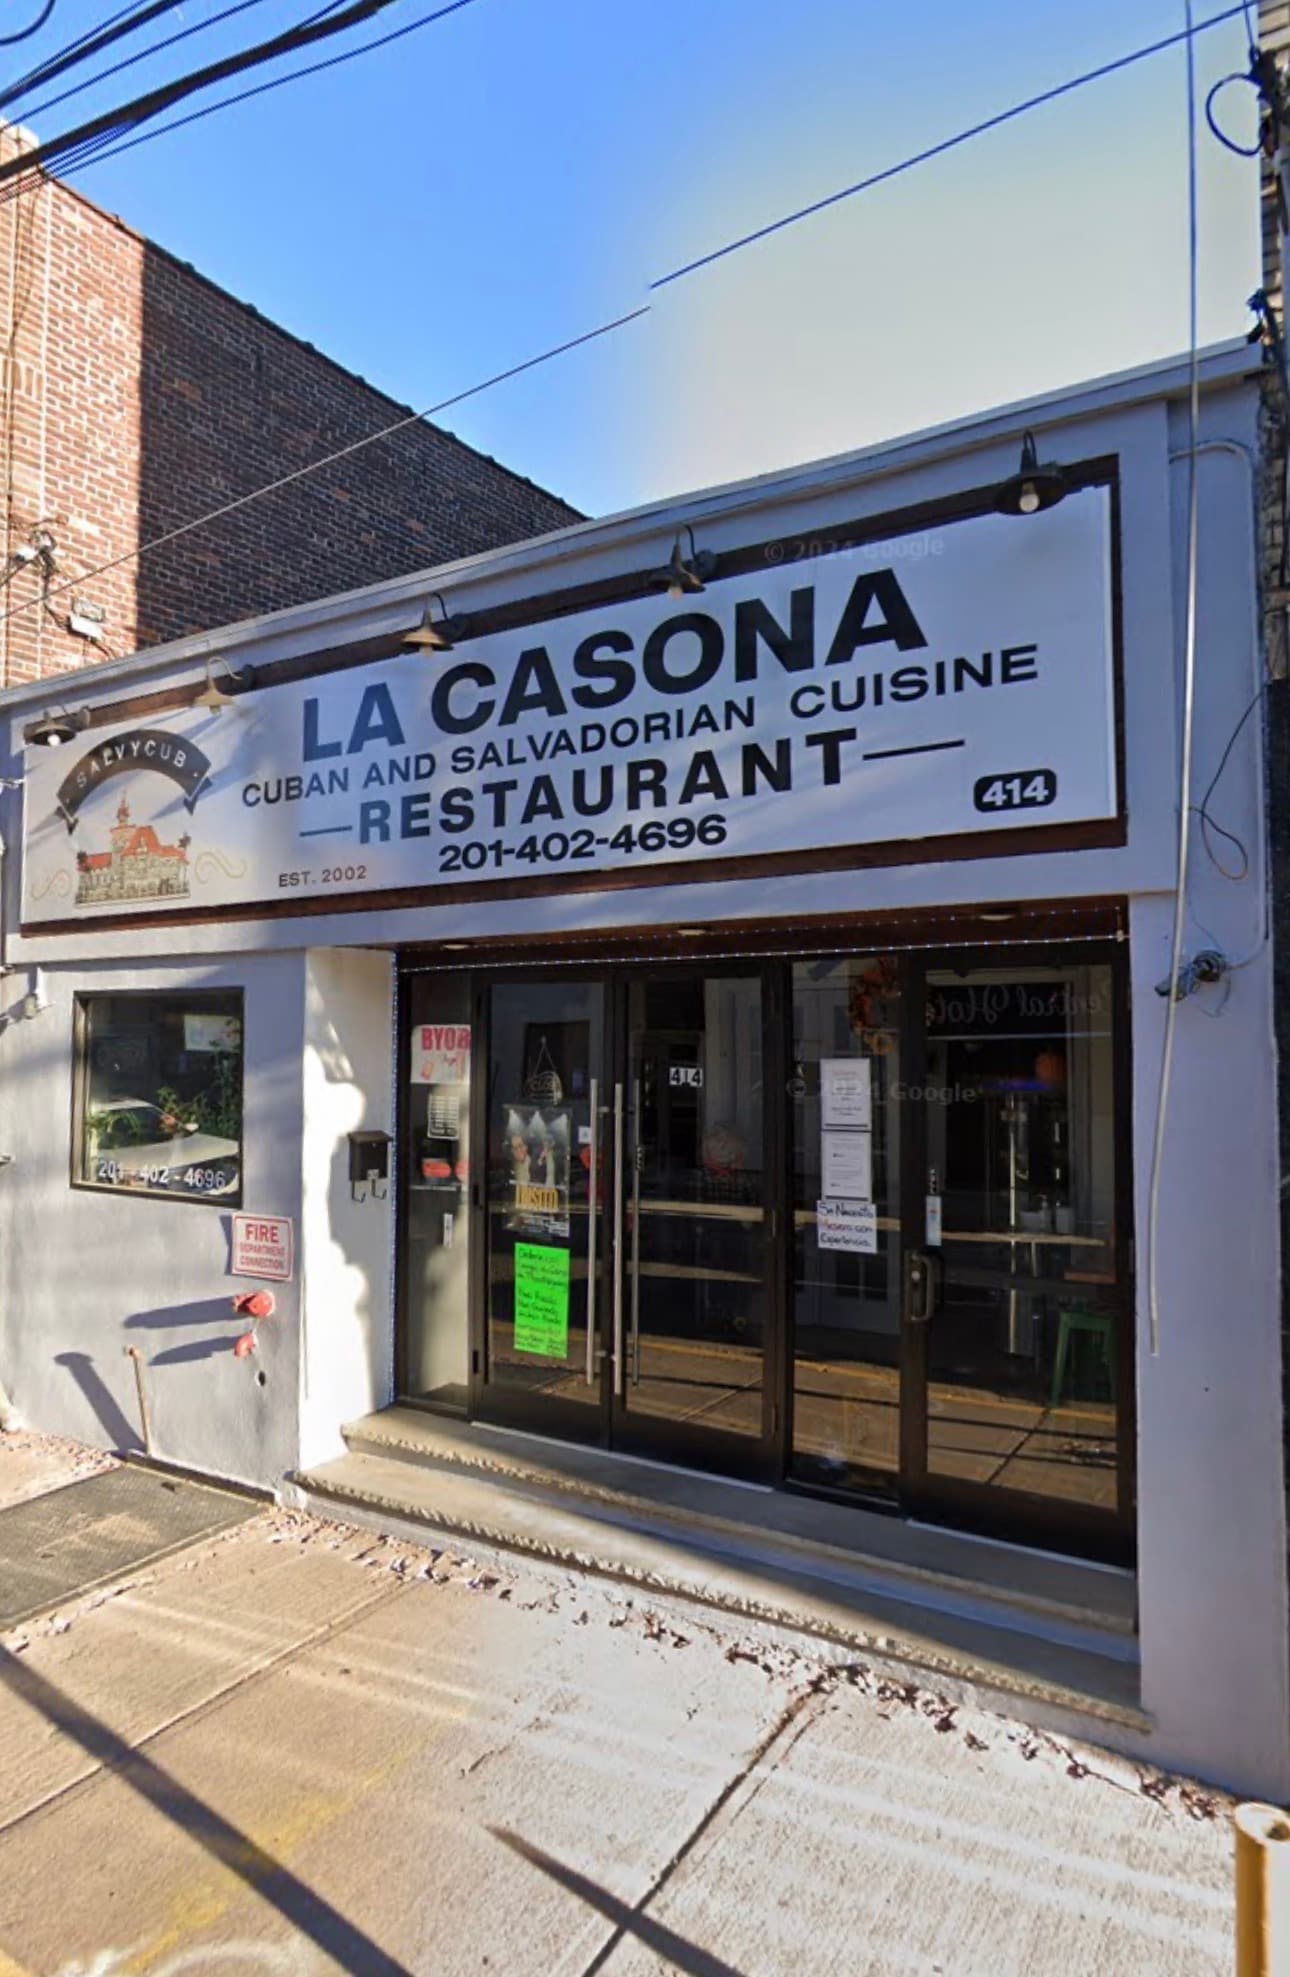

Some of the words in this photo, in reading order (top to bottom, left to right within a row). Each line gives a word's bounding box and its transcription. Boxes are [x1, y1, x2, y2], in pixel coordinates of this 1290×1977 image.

[302, 682, 405, 762] LA
[430, 568, 928, 735] CASONA
[241, 766, 349, 808] CUBAN
[362, 753, 436, 790] AND
[450, 696, 755, 775] SALVADORIAN
[790, 644, 1038, 719] CUISINE
[359, 727, 857, 845] RESTAURANT
[981, 774, 1050, 807] 414
[438, 814, 727, 873] 201-402-4696
[278, 872, 317, 888] EST.
[321, 865, 367, 882] 2002
[421, 1026, 471, 1051] BYOB
[670, 1067, 703, 1086] 414
[245, 1223, 281, 1243] FIRE
